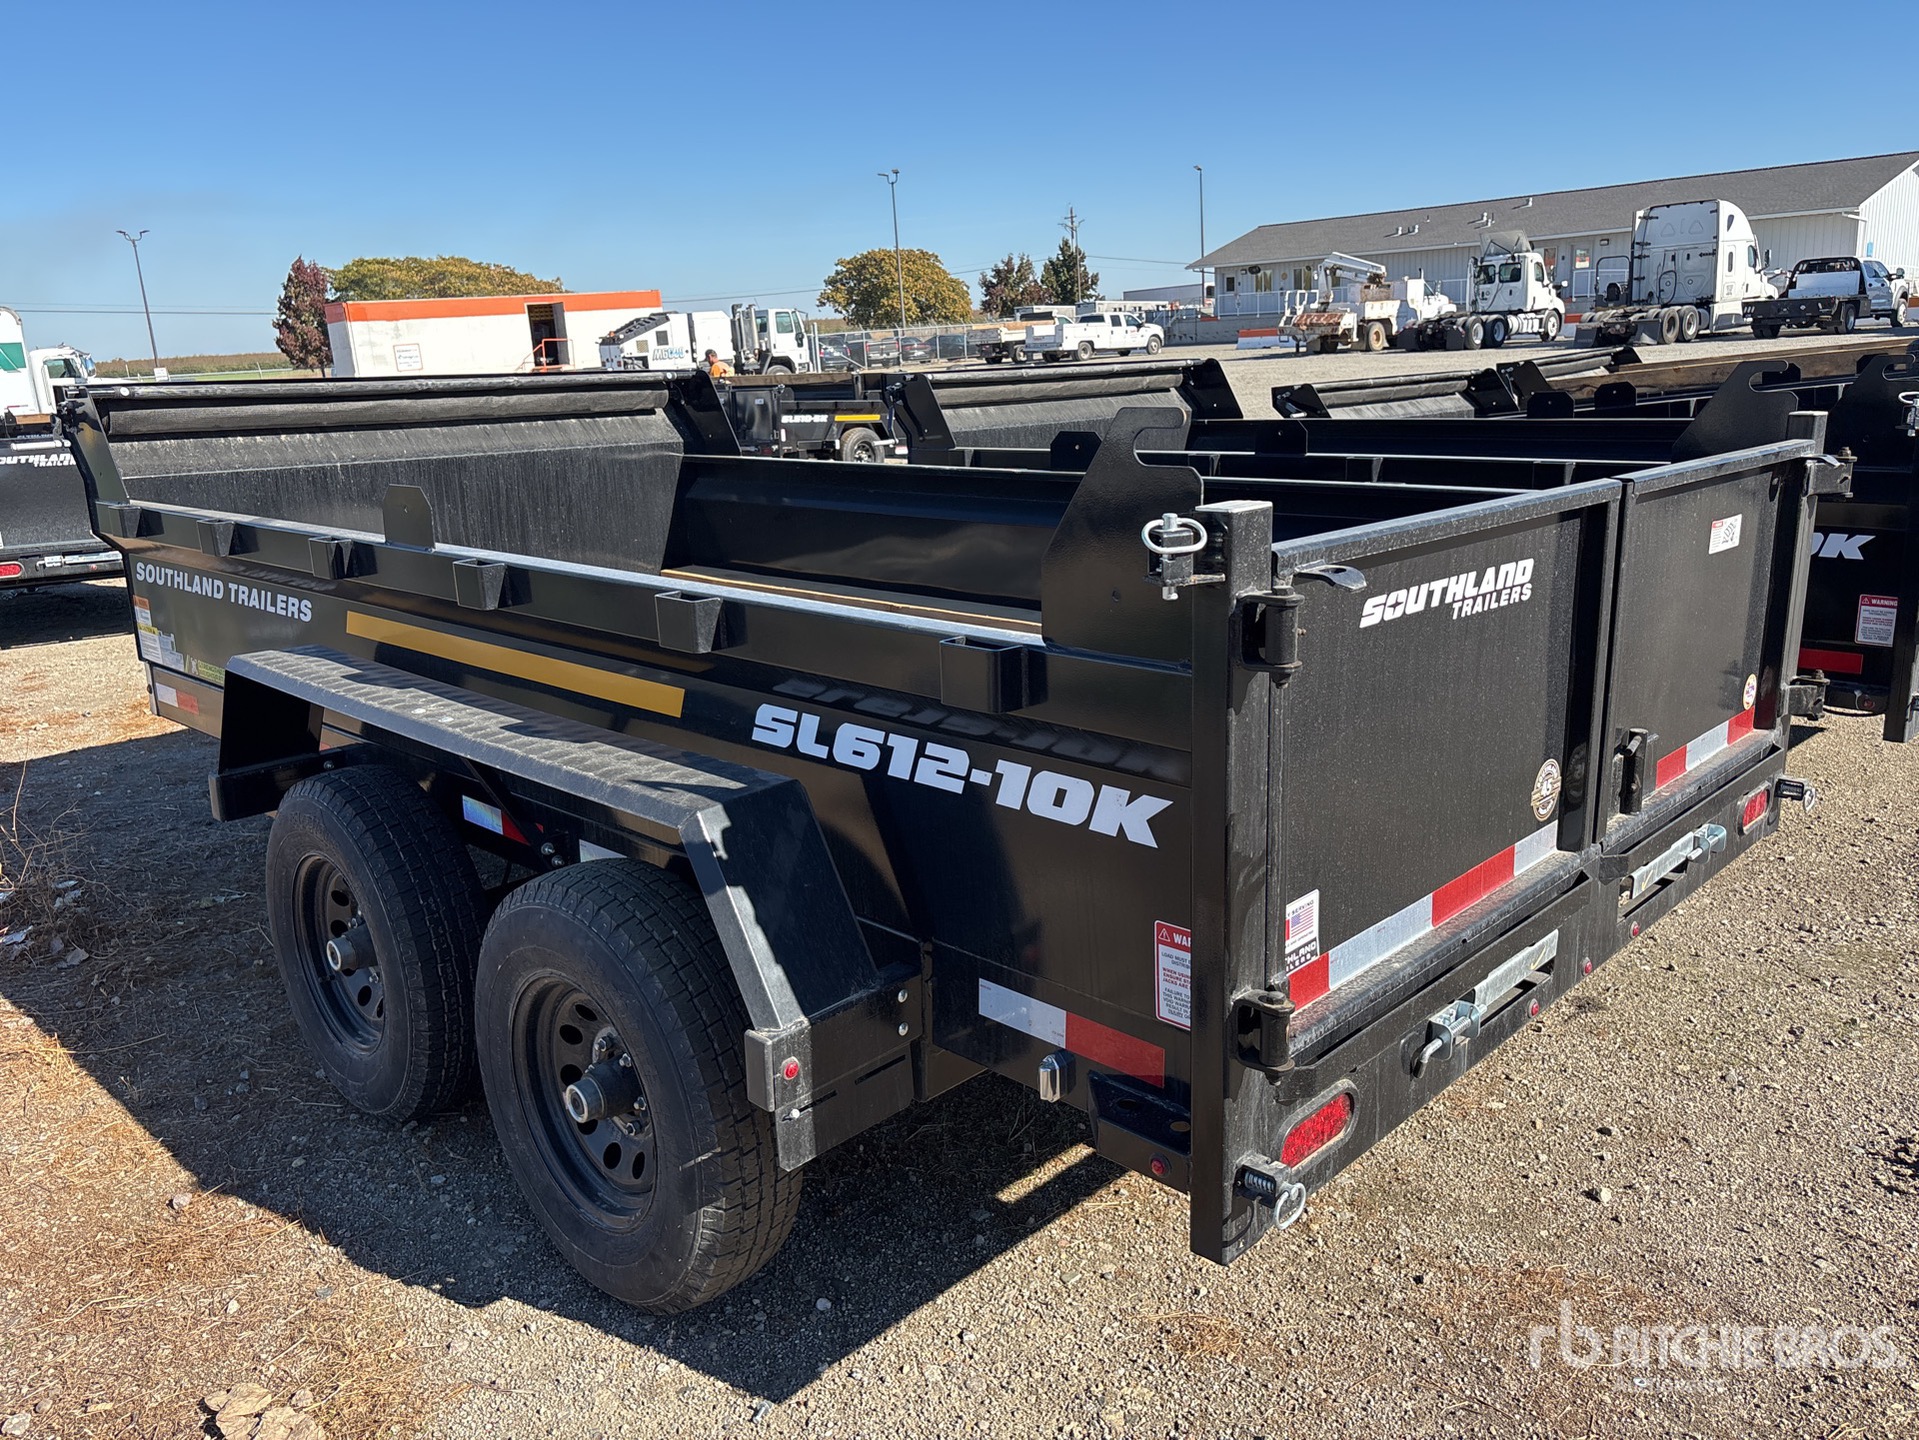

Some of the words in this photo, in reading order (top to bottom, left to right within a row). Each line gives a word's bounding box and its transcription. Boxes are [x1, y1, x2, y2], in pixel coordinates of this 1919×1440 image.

[1811, 532, 1876, 560] K
[136, 562, 224, 600] SOUTHLAND
[228, 582, 312, 623] TRAILERS
[1359, 558, 1534, 628] SOUTHLAND
[1452, 583, 1532, 620] TRAILERS
[1871, 598, 1898, 606] WARNING
[751, 702, 1174, 849] SL612-10K
[1161, 951, 1174, 960] LOAD
[1162, 967, 1177, 976] WHEN
